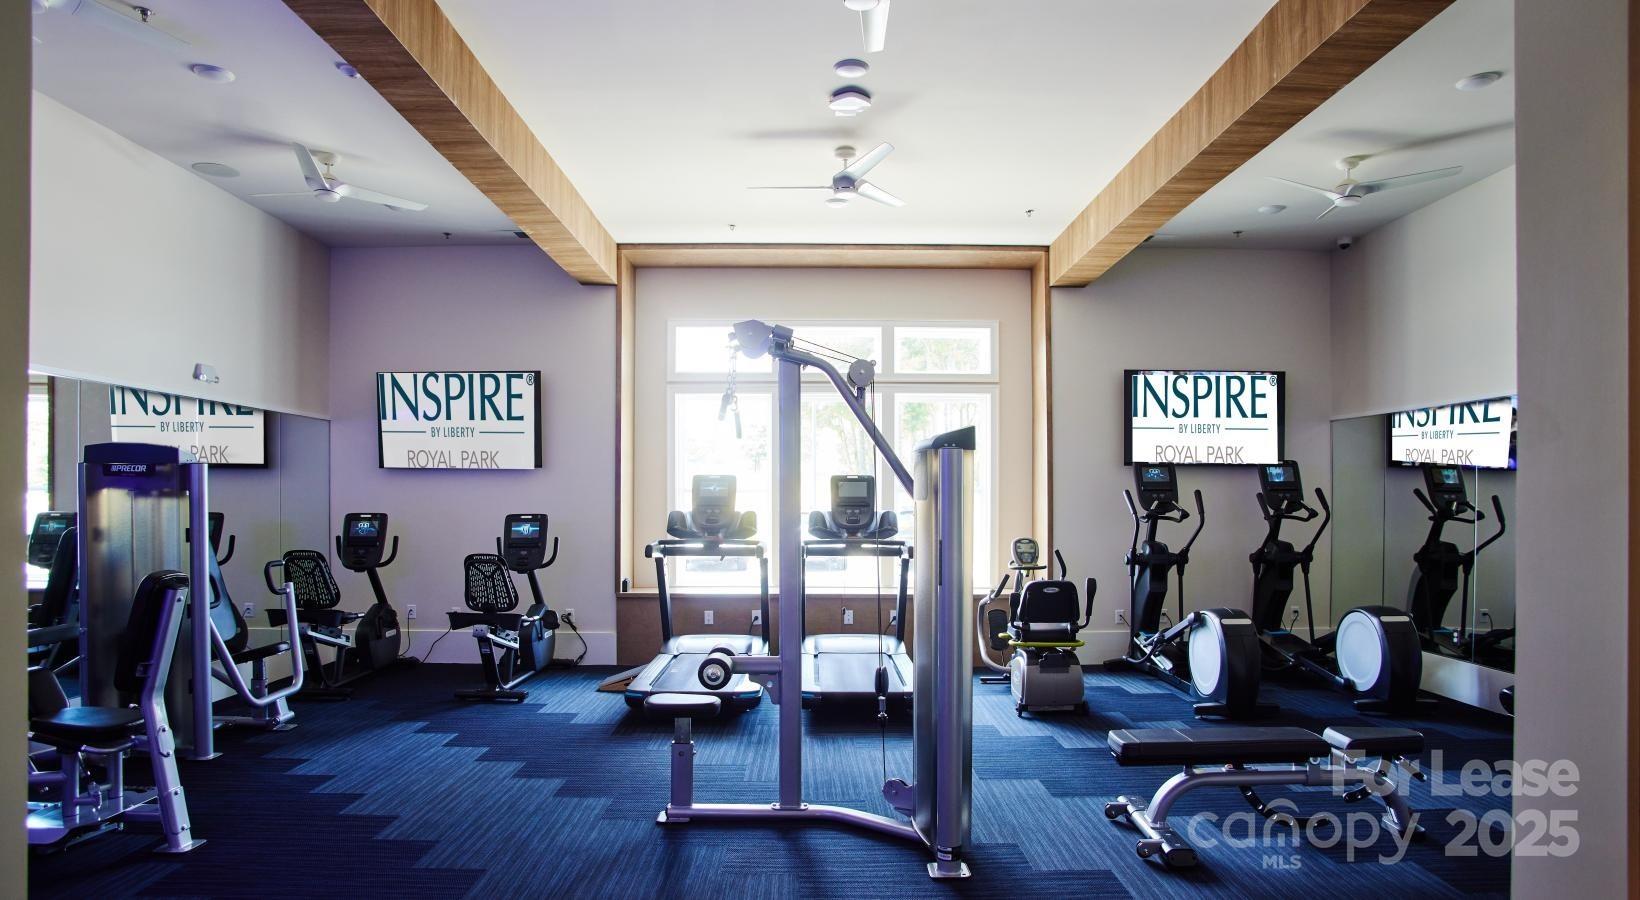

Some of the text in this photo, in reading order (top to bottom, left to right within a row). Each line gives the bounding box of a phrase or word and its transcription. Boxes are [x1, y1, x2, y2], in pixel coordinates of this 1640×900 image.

[160, 421, 204, 433] BY LIBERTY
[431, 427, 475, 438] BY LIBERTY
[1178, 424, 1221, 434] BY LIBERTY
[1421, 430, 1454, 440] BY LIBERTY
[407, 449, 500, 469] ROYAL PARK
[1155, 445, 1245, 463] ROYAL PARK
[1405, 448, 1474, 465] ROYAL PARK
[116, 464, 147, 472] PRECOR
